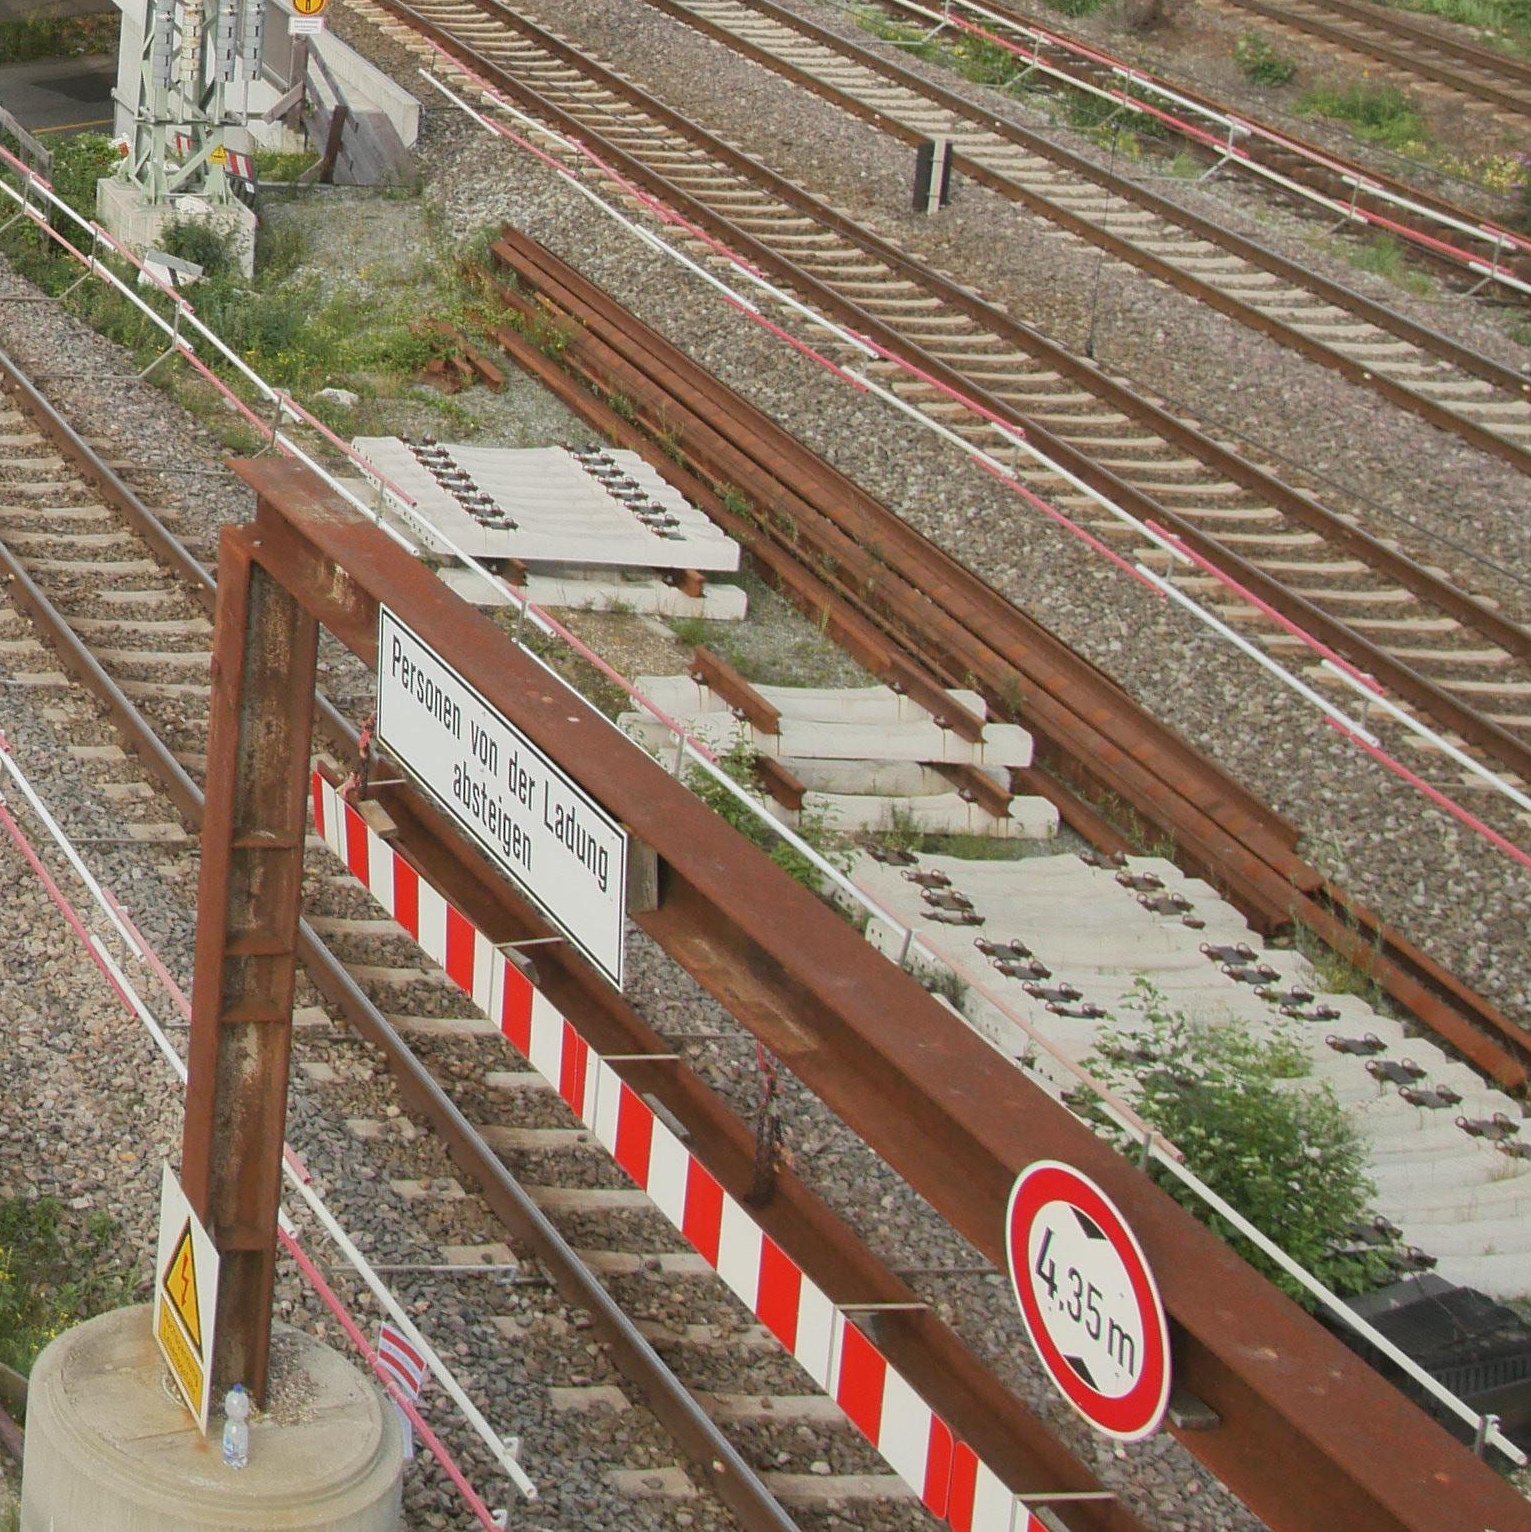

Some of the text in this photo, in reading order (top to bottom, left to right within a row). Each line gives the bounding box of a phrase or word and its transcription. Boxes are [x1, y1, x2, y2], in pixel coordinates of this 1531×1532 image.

[392, 634, 609, 893] Personen von der Ladung
[453, 761, 531, 872] absteigen
